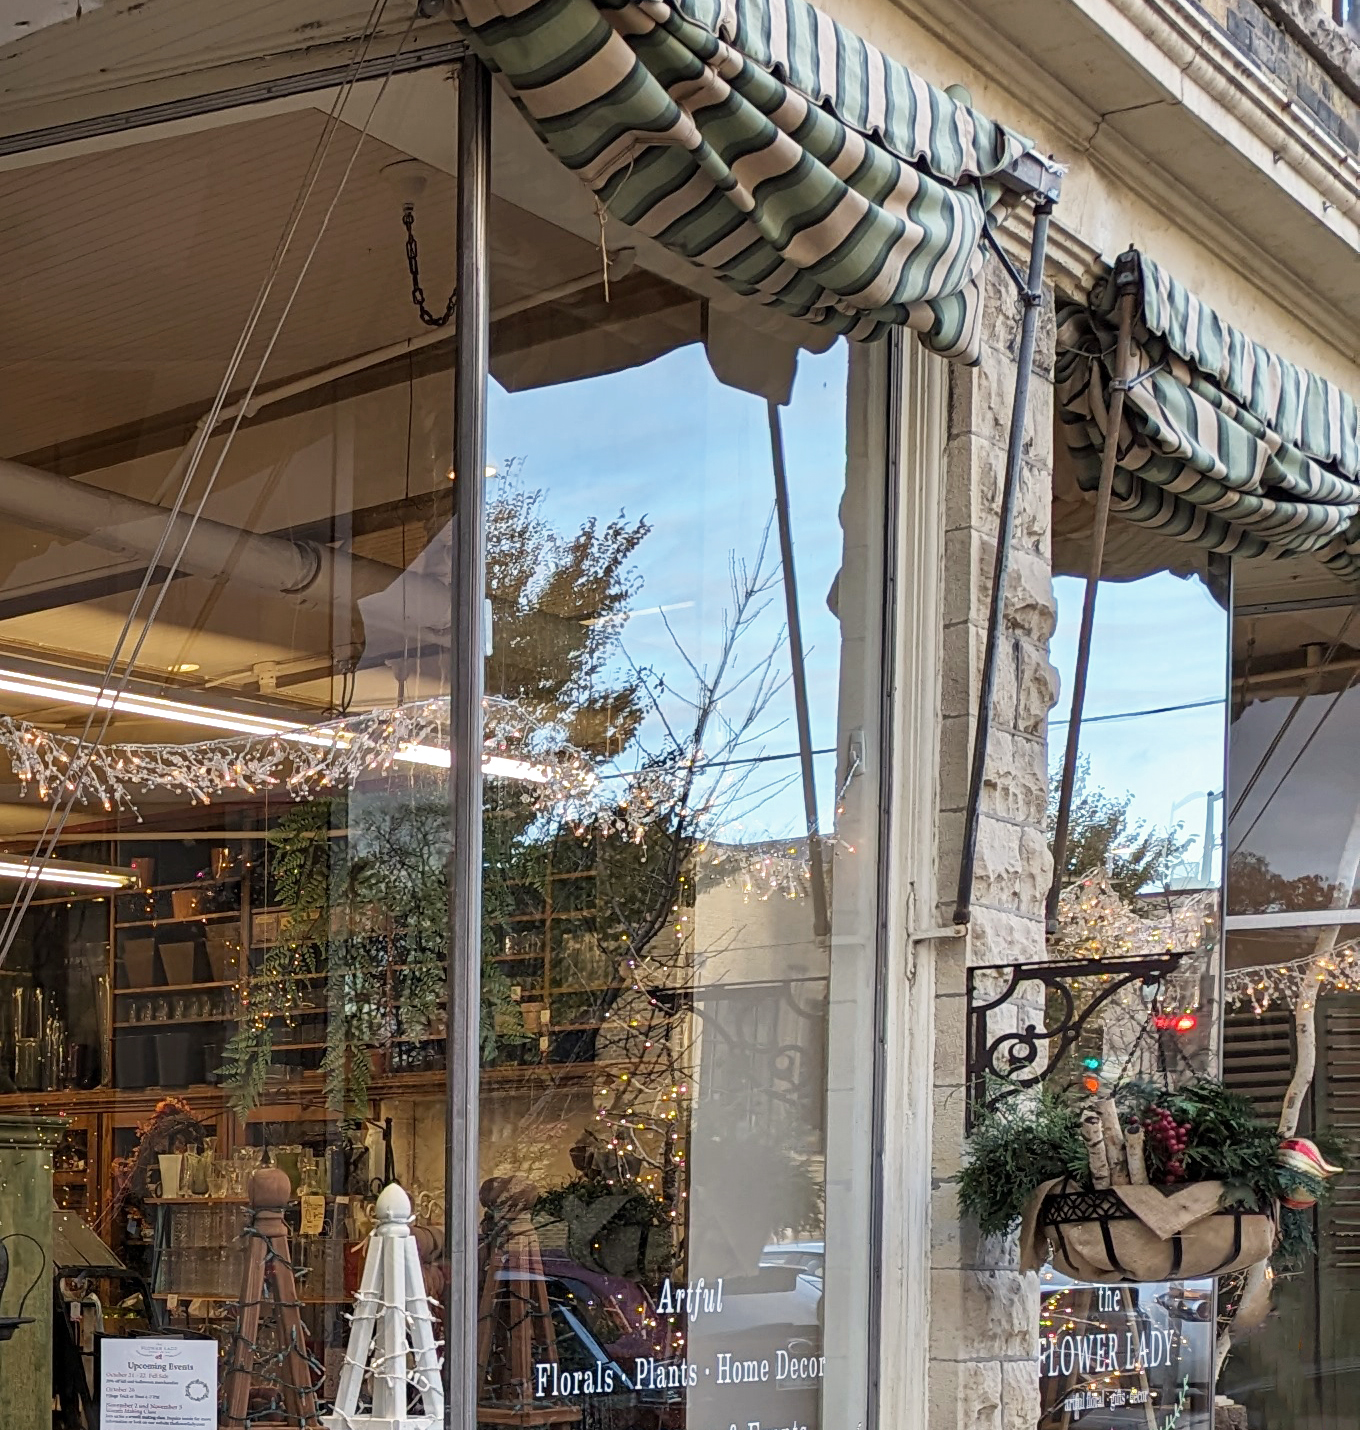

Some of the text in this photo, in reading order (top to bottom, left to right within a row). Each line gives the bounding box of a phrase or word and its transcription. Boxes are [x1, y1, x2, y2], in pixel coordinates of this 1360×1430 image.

[656, 1276, 724, 1322] Artful
[1097, 1285, 1121, 1313] the
[128, 1361, 194, 1373] Upcoming Events
[535, 1349, 827, 1399] Florals Plants Home Decor
[1037, 1329, 1175, 1378] FLOWER LADY
